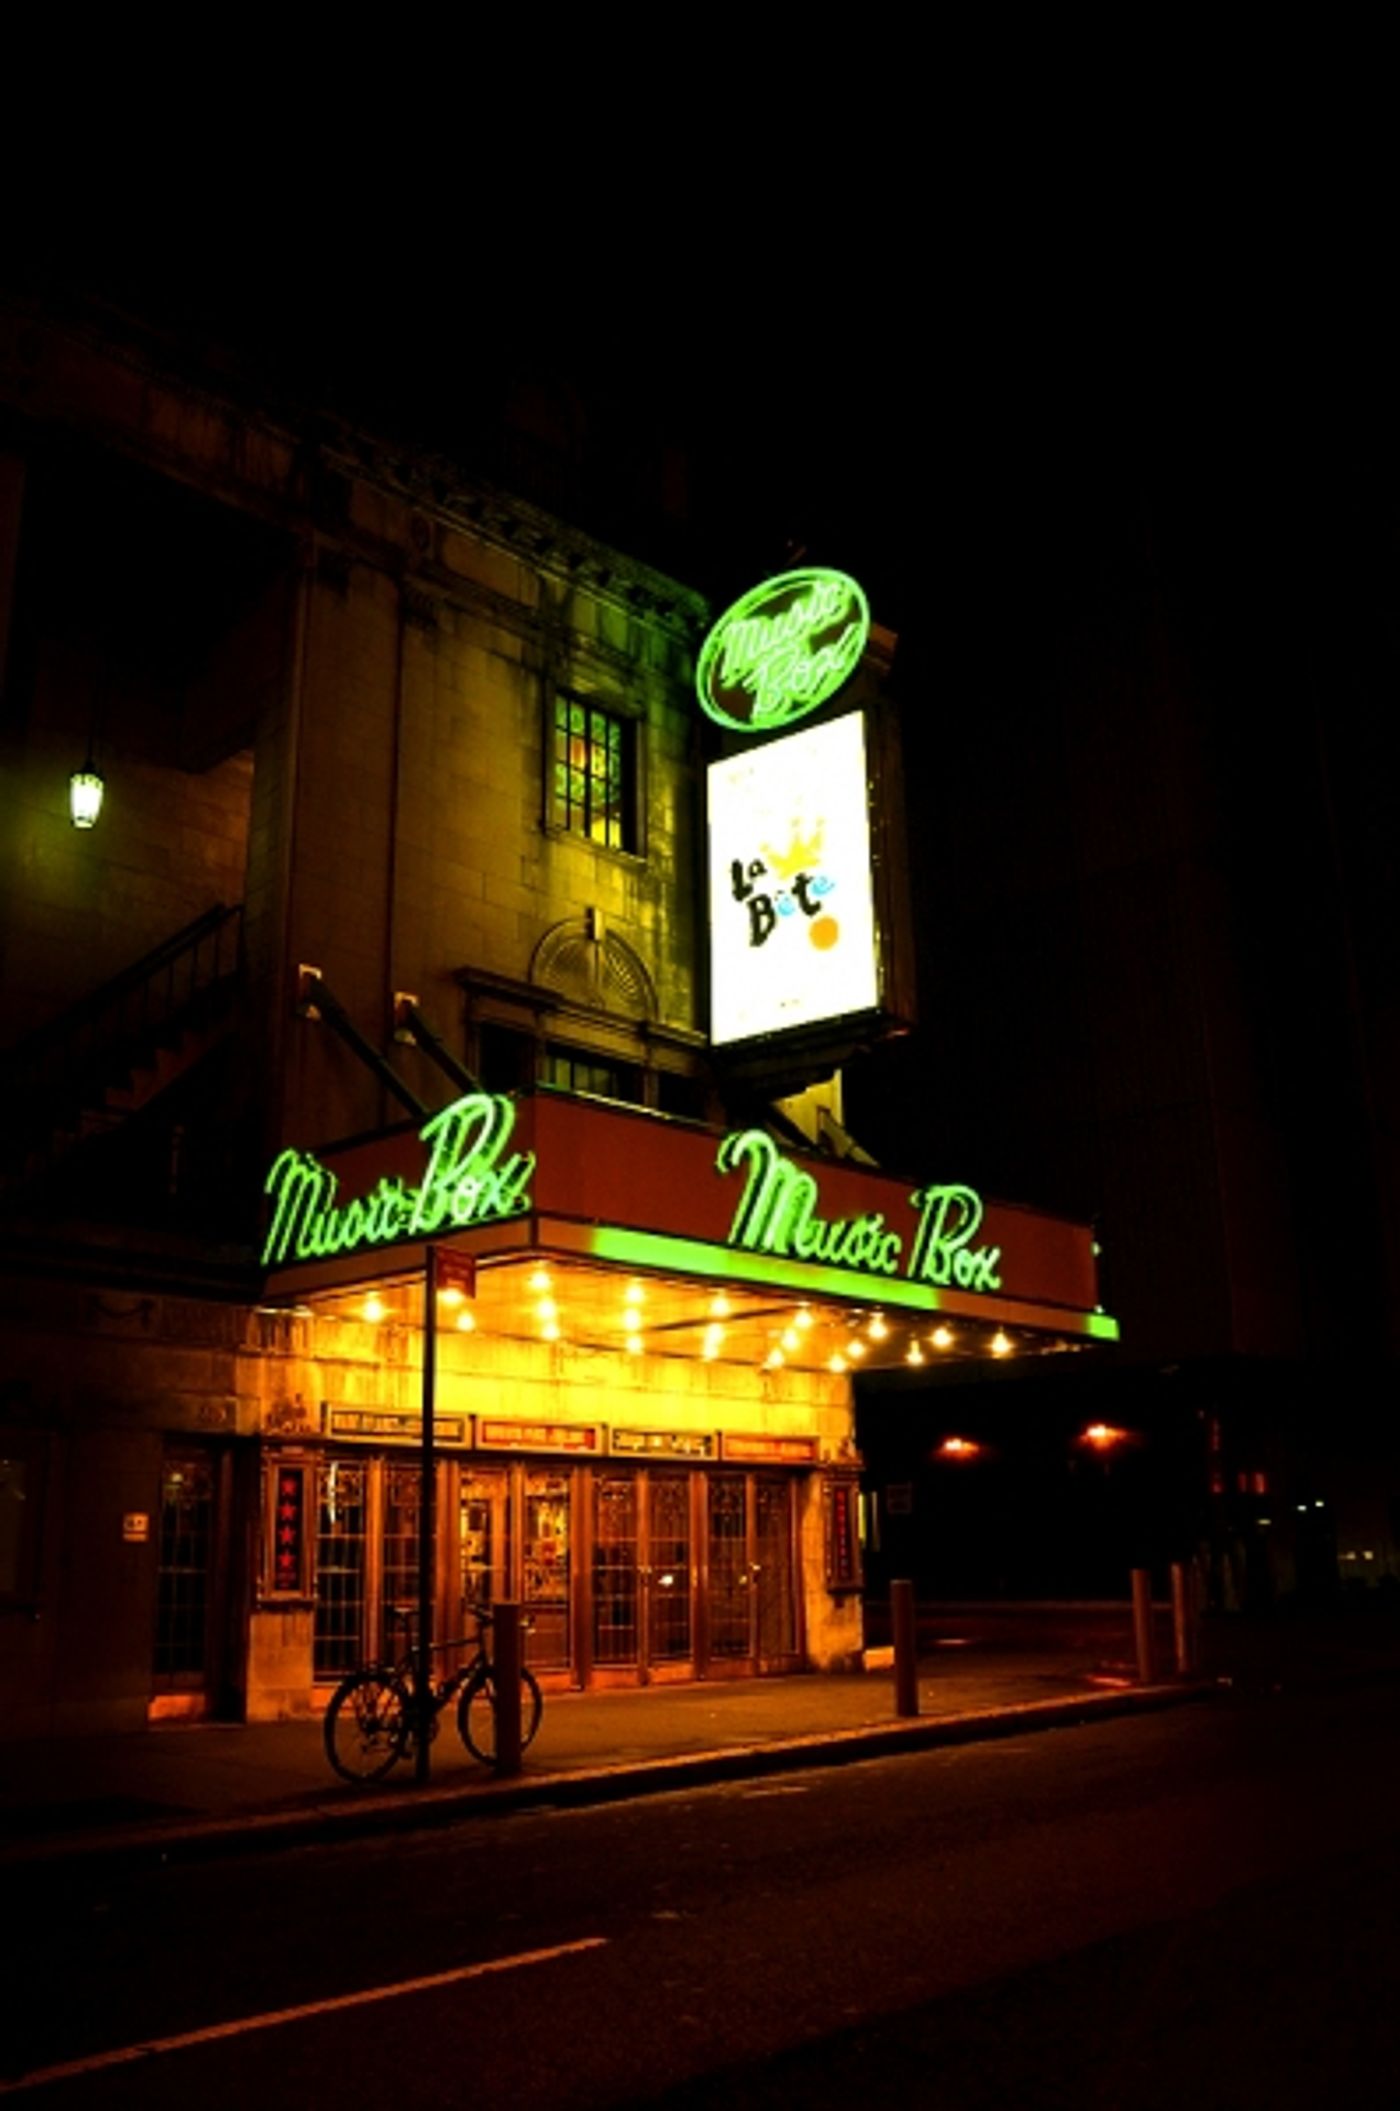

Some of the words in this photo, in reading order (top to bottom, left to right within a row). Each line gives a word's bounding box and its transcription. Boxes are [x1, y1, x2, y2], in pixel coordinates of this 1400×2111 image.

[720, 578, 847, 688] Music
[742, 622, 862, 726] Box
[731, 858, 768, 903] La
[261, 1148, 404, 1265] Music
[408, 1093, 537, 1235] Box
[716, 1129, 902, 1274] Music
[907, 1184, 1002, 1292] Box
